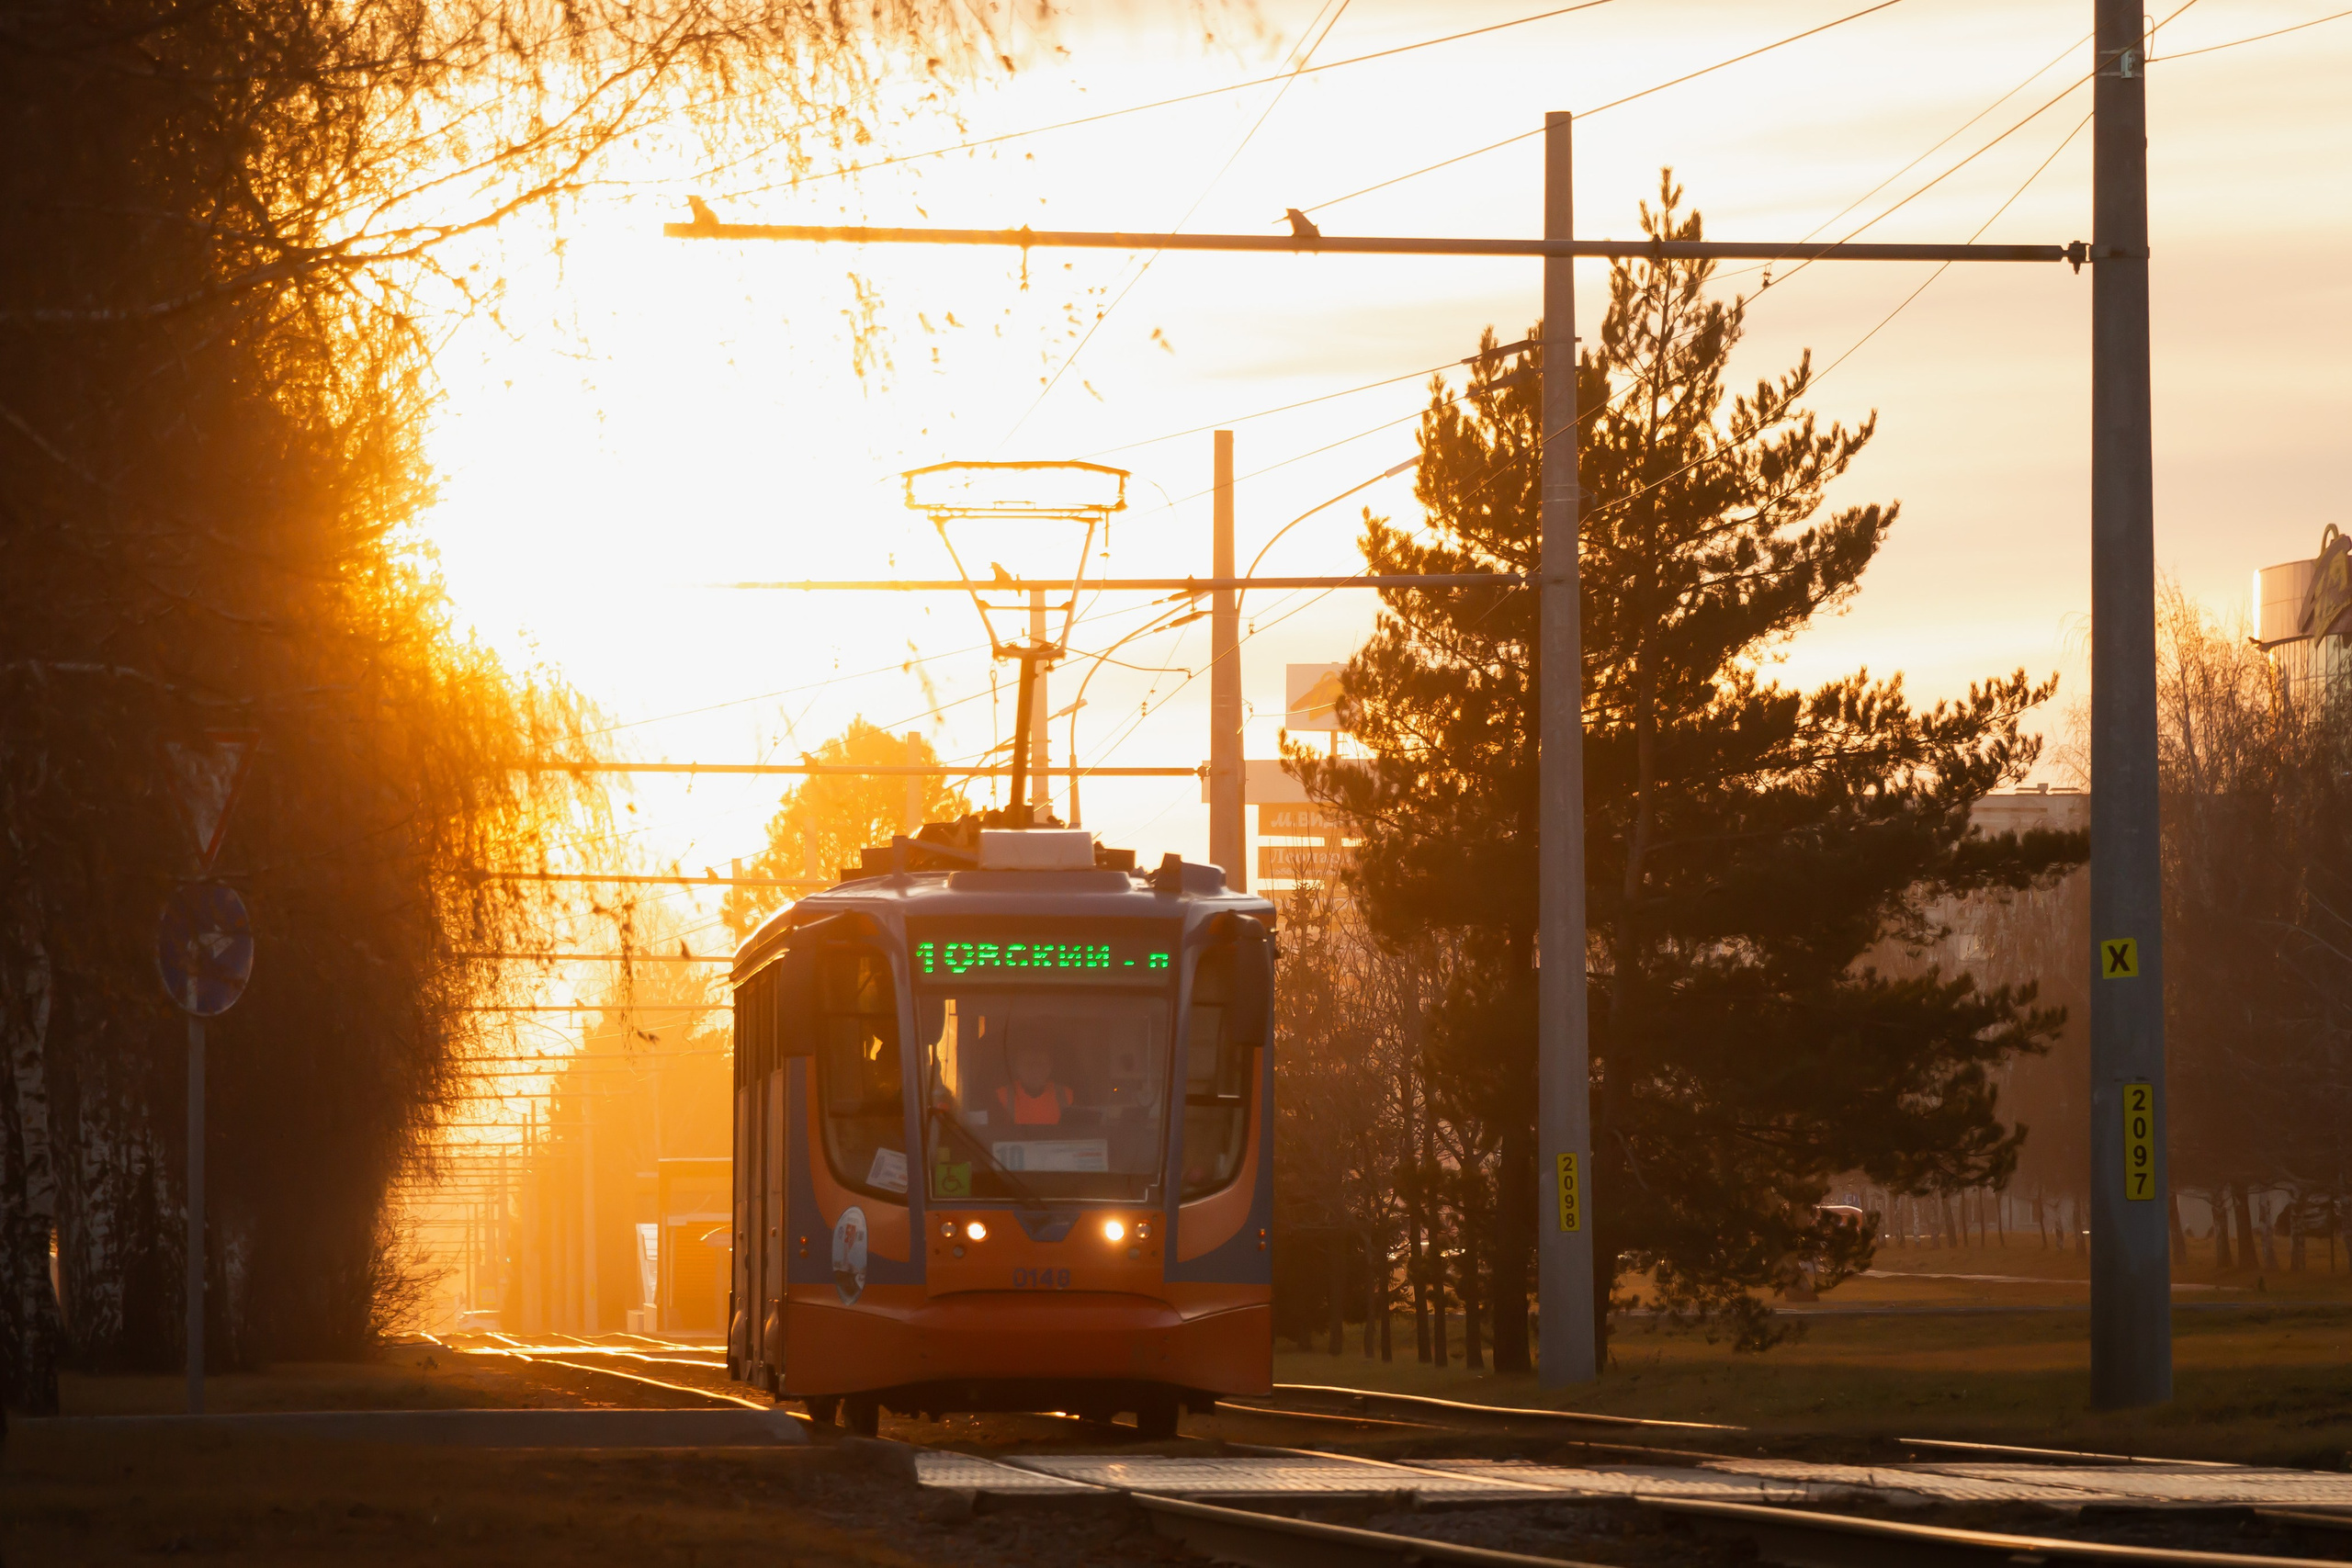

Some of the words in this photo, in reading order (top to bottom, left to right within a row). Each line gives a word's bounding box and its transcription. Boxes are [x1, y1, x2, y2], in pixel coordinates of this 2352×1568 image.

[2132, 1089, 2147, 1195] 2097
[1562, 1156, 1576, 1228] 2098
[1012, 1268, 1070, 1288] 0148
